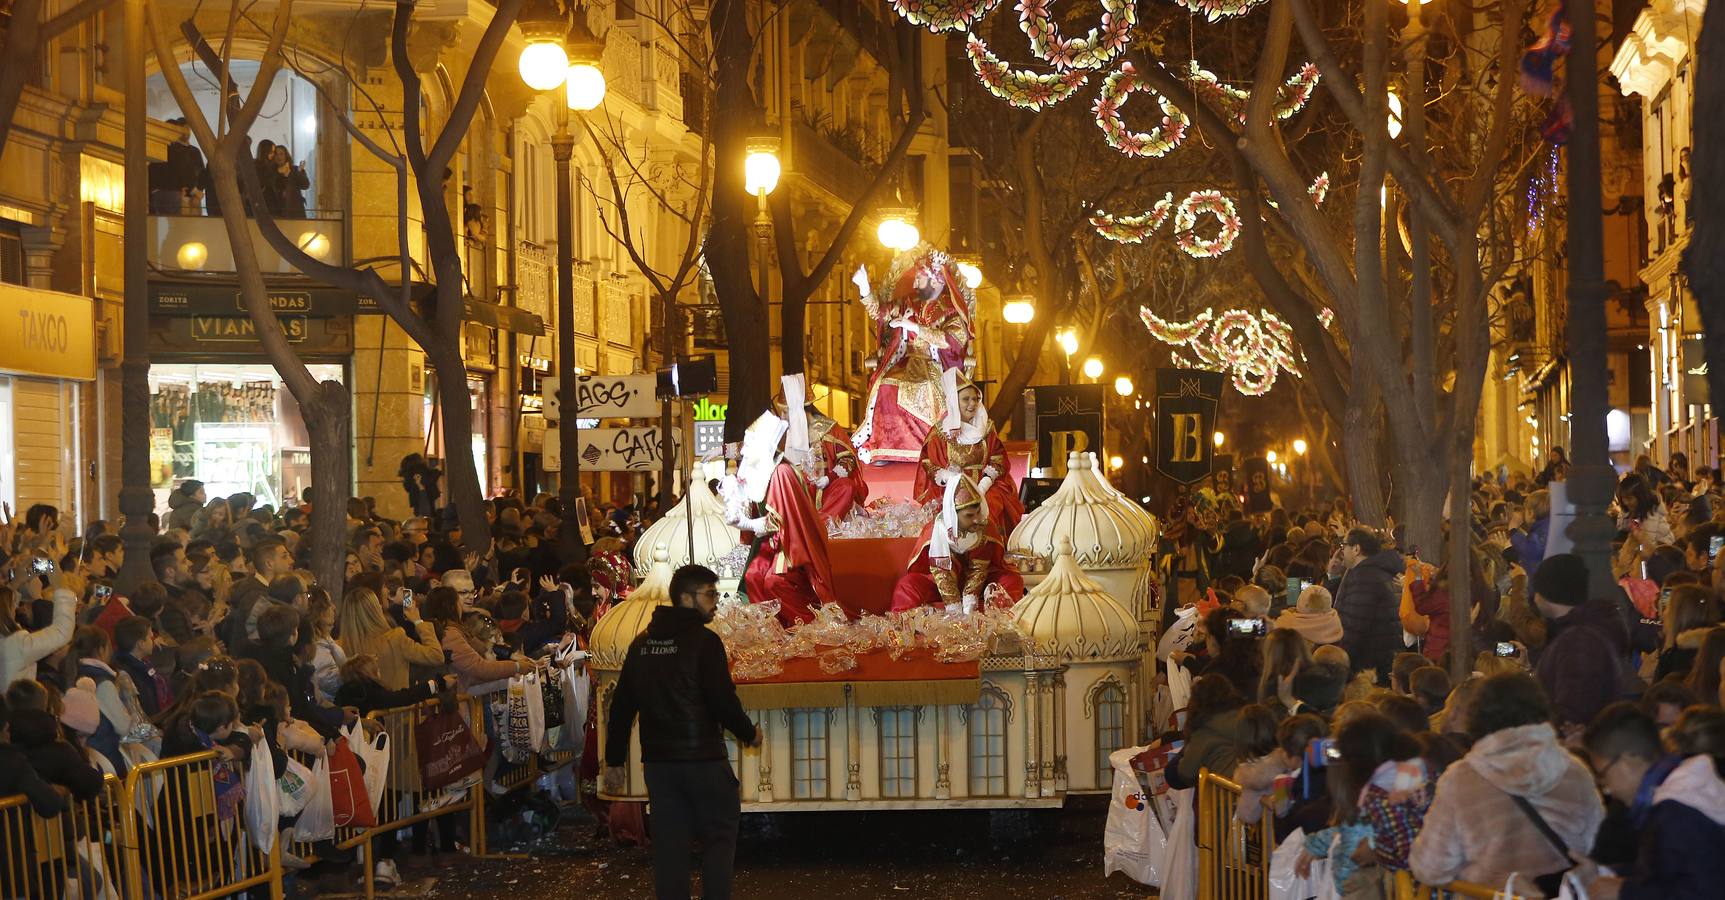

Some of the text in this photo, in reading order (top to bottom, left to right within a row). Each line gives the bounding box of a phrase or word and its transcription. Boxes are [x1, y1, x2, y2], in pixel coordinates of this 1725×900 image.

[19, 310, 68, 354] TAXCO
[198, 317, 302, 336] VIANAS
[1170, 413, 1202, 462] B
